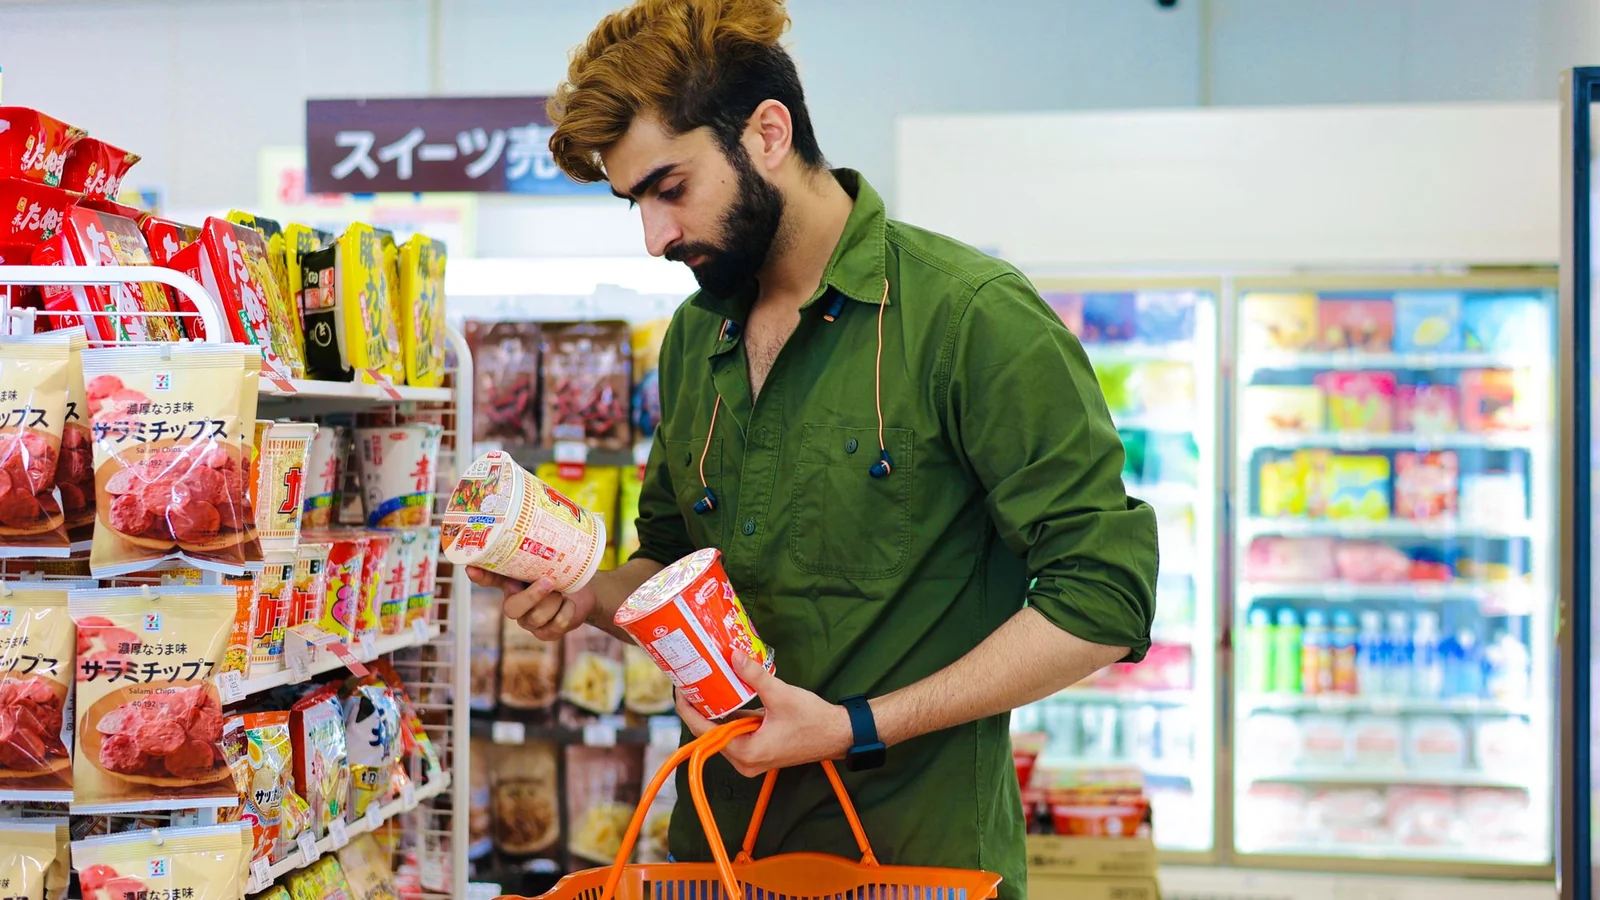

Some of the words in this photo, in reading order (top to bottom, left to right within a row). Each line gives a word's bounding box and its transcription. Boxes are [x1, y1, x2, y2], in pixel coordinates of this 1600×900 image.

[126, 402, 194, 415] 濃厚なうま味
[92, 416, 228, 443] サラミチップス
[118, 643, 188, 656] 濃厚なうま味
[81, 658, 216, 683] サラミチップス
